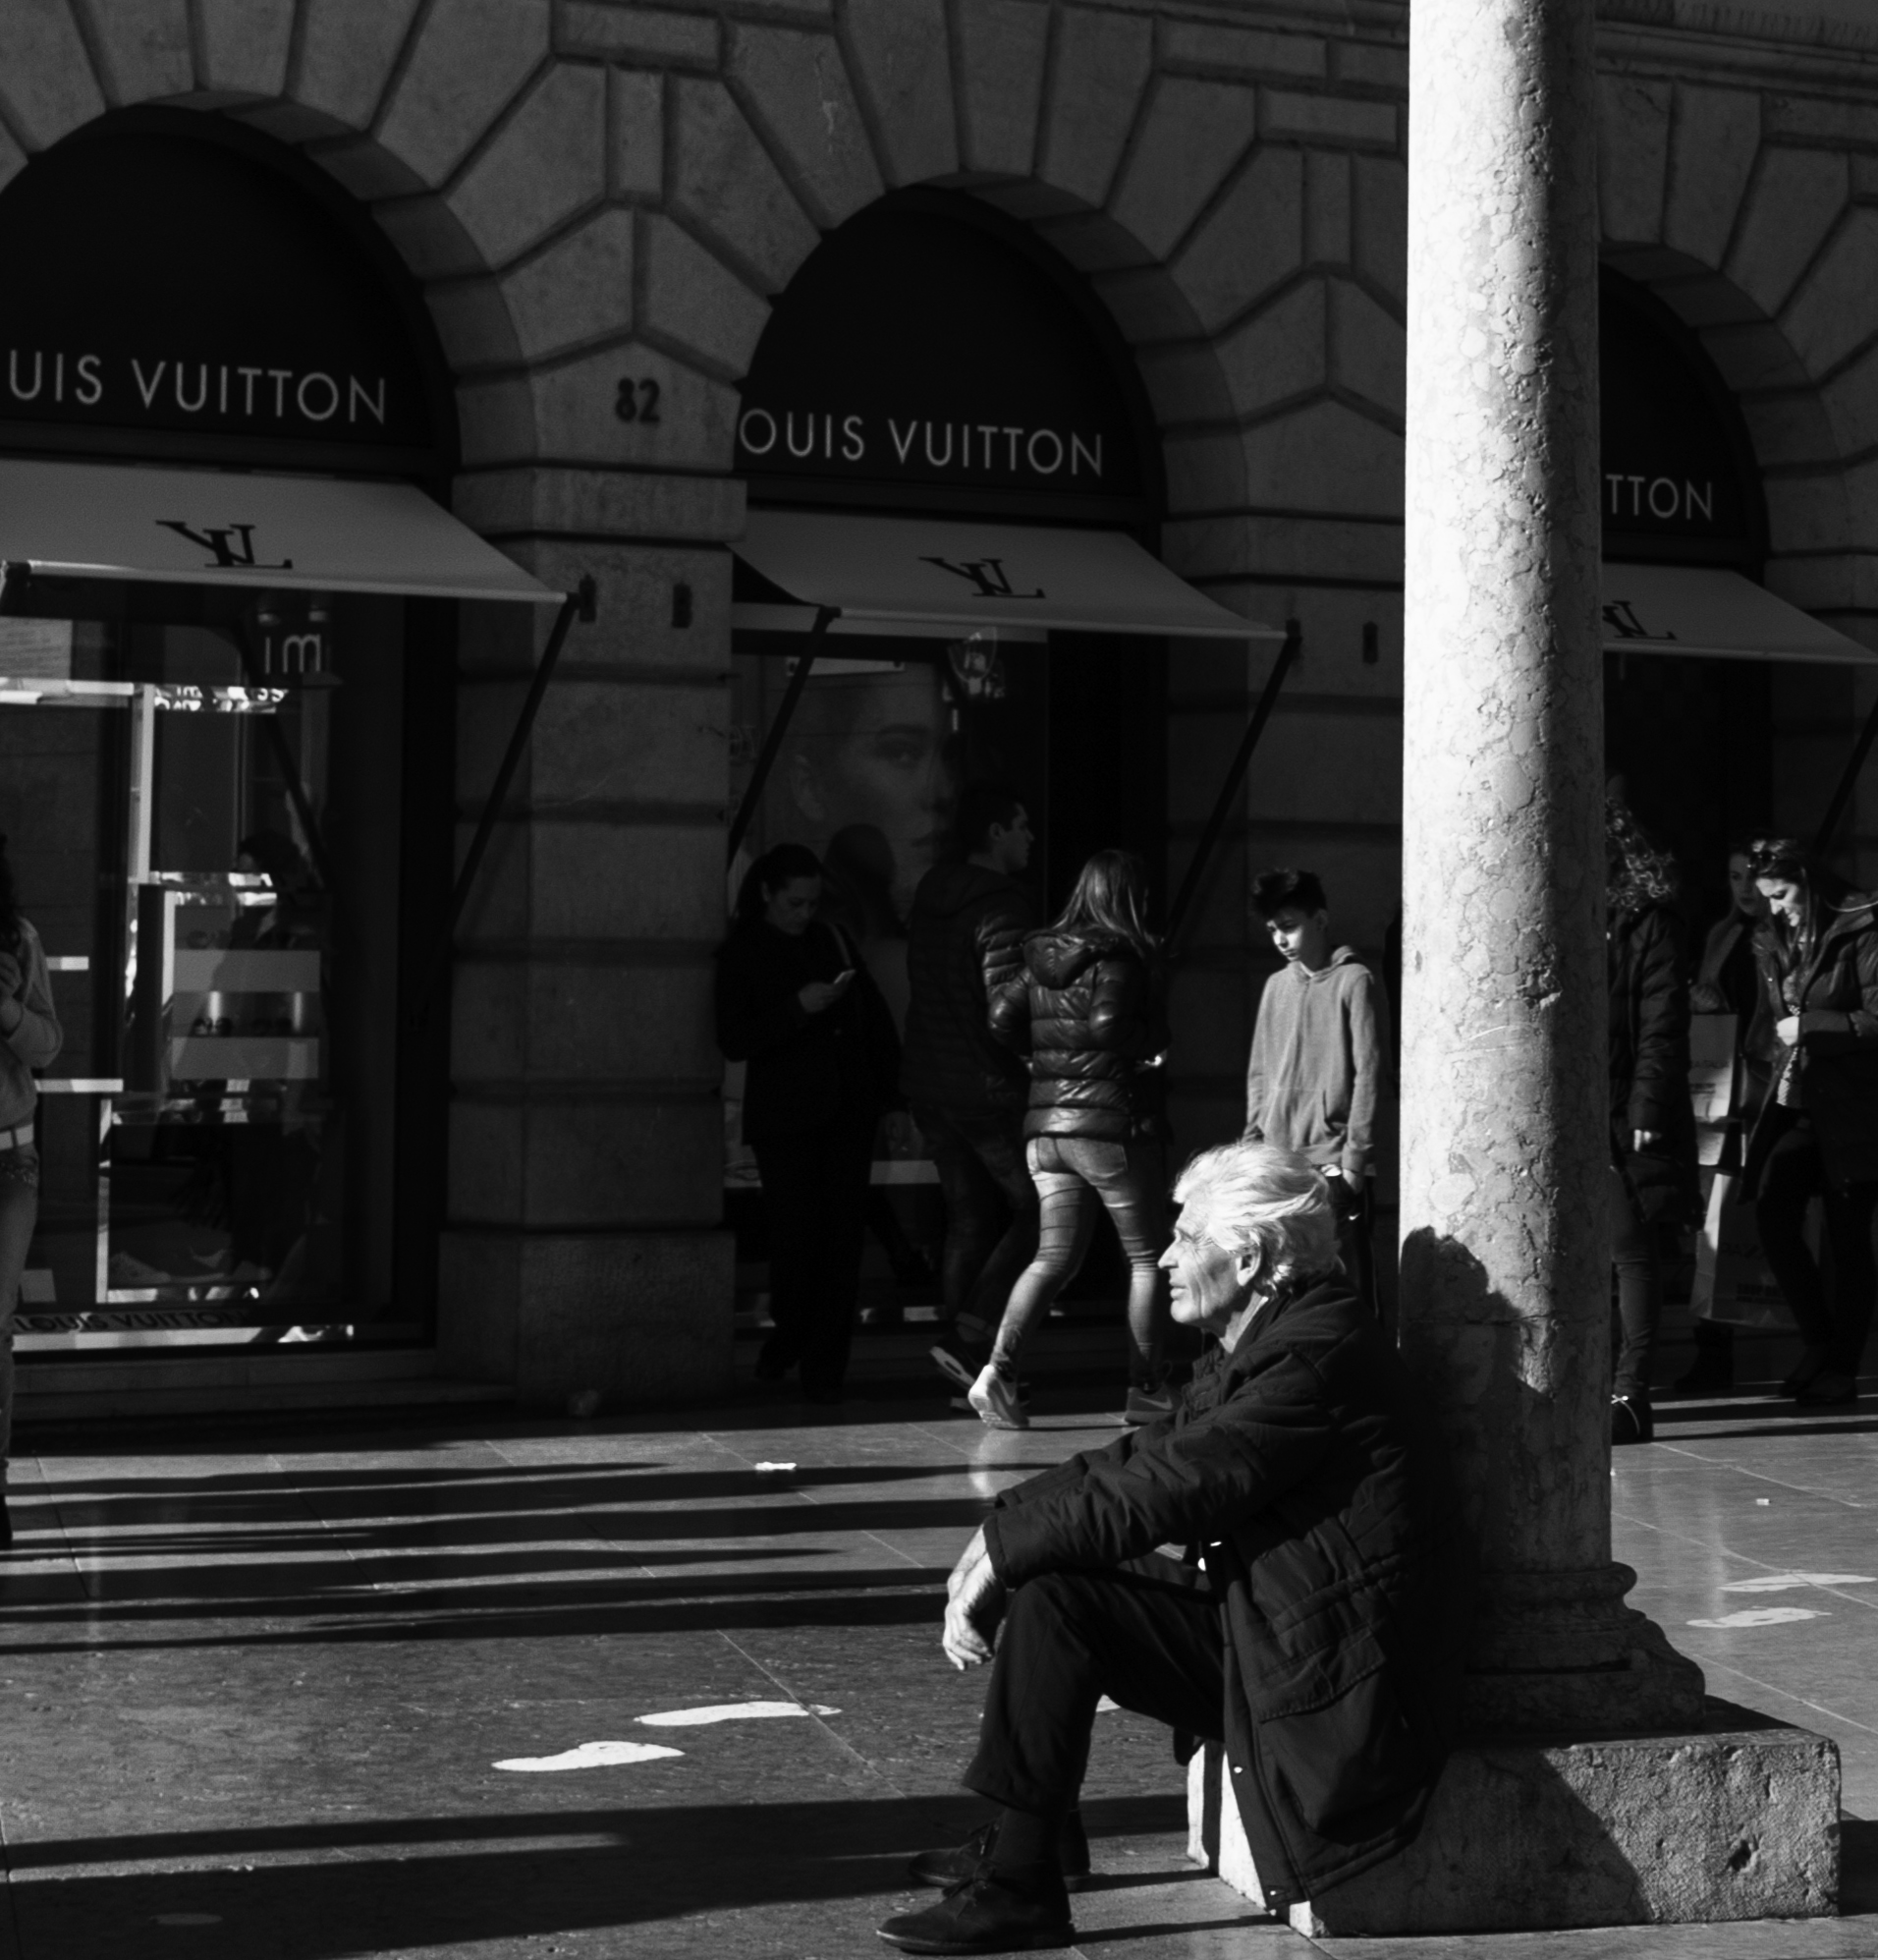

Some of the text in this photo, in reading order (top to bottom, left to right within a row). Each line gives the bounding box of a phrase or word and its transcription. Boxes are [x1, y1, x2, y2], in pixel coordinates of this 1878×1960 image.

[9, 349, 386, 426] UIS VUITTON
[615, 377, 660, 422] 82
[739, 407, 1103, 478] OUIS VUITTON
[1604, 473, 1713, 523] TTON
